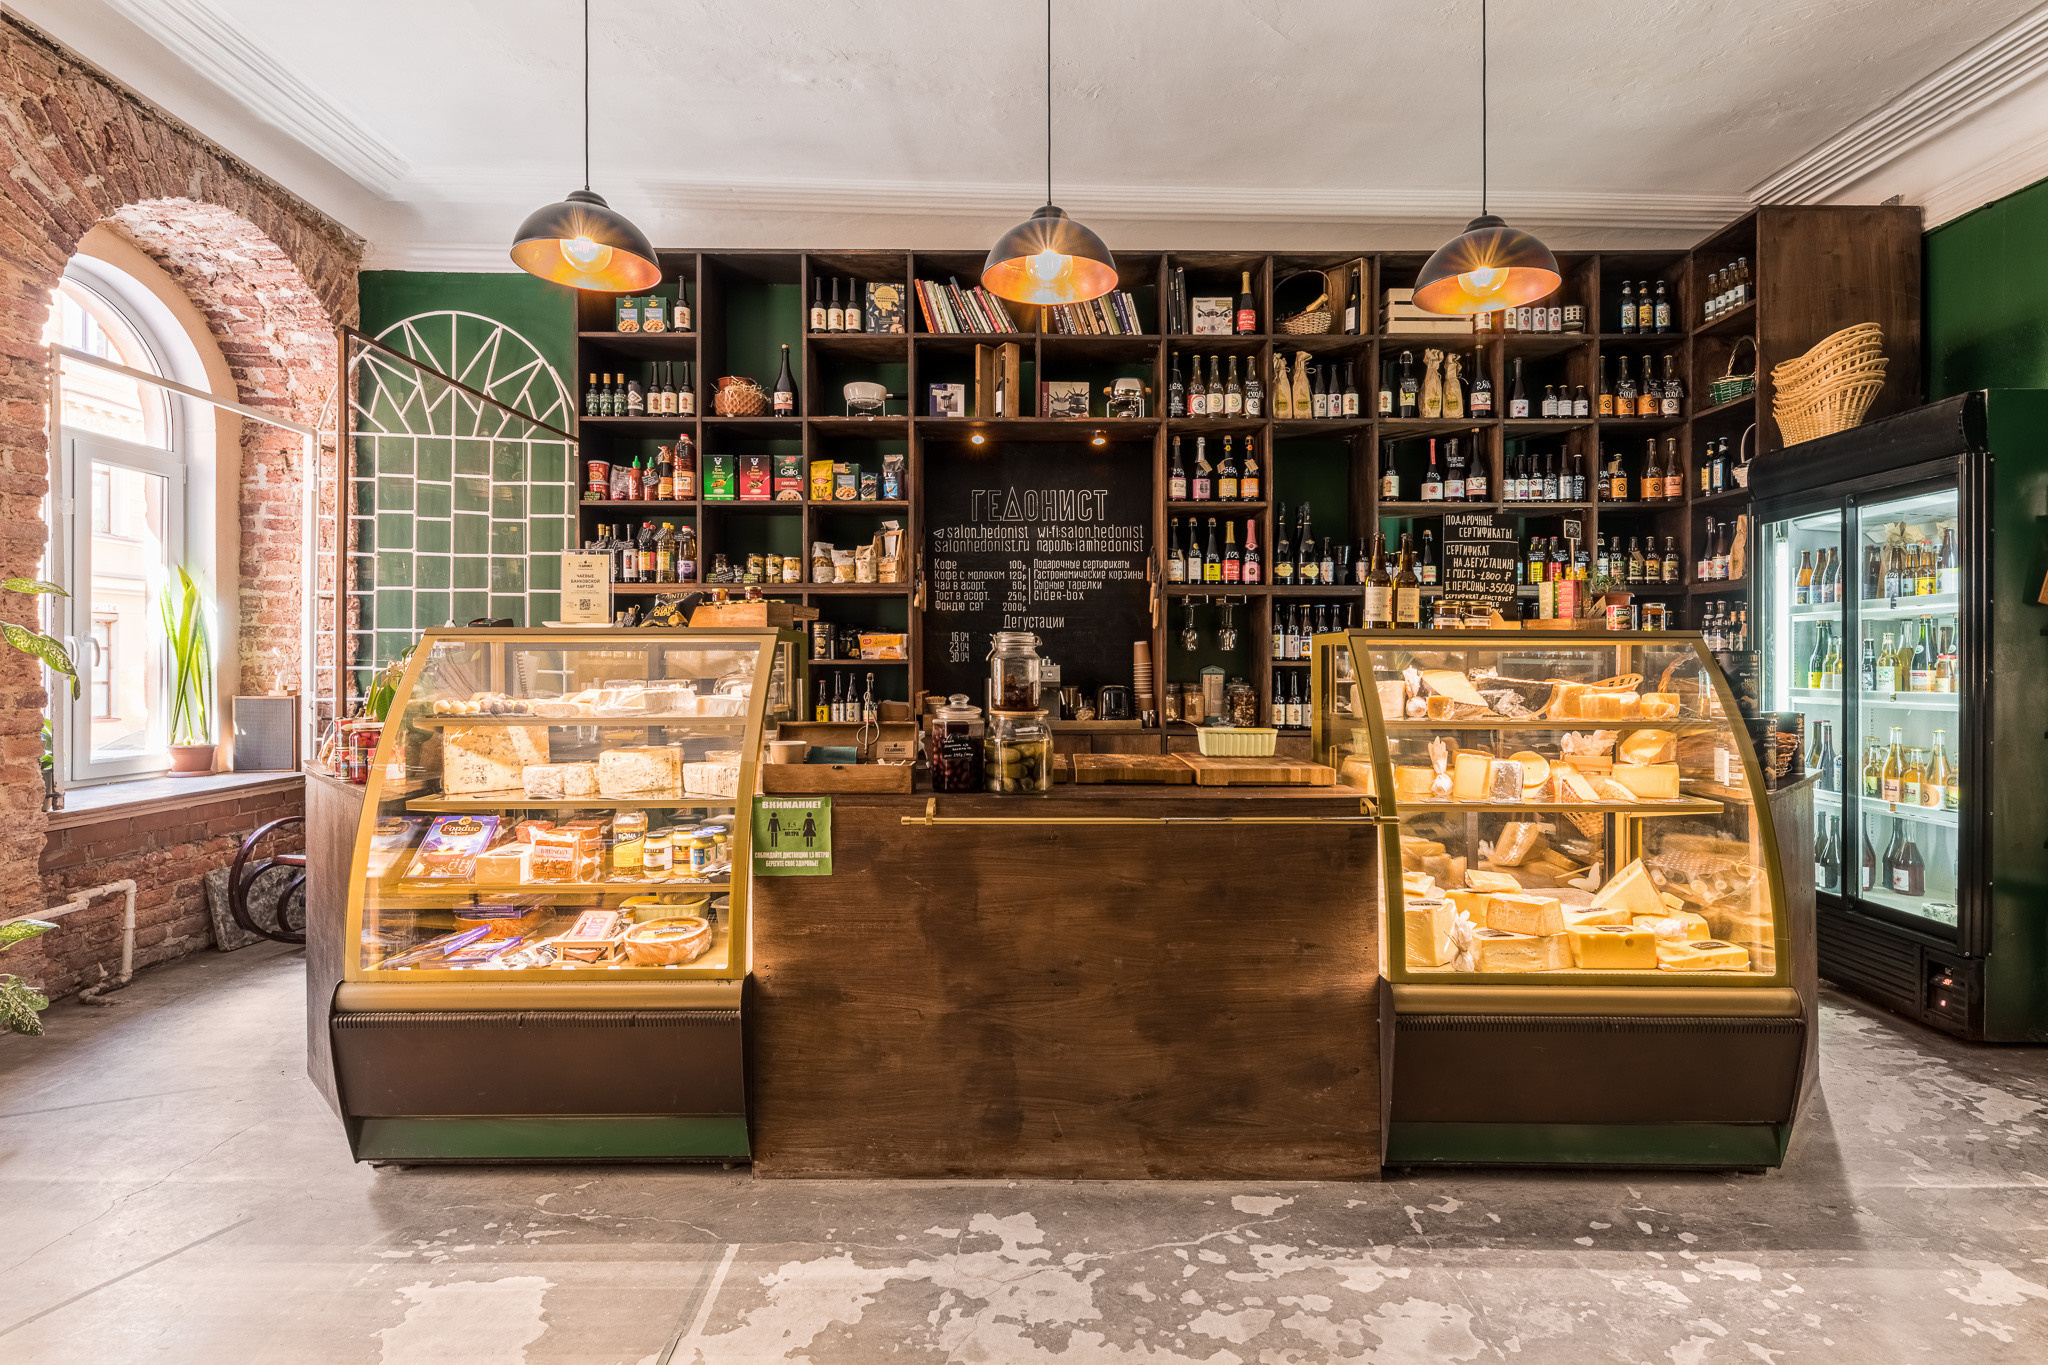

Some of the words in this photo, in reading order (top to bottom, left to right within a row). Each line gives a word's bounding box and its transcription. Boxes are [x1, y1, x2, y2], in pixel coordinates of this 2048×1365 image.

[781, 468, 803, 476] Gallo
[972, 486, 1108, 522] ГЕДОНИСТ
[1445, 515, 1493, 526] ПОДАРОЧНЫЕ
[947, 523, 1029, 539] salon_hedonist
[1459, 527, 1512, 539] СЕРТИФИКАТЫ
[934, 539, 1030, 552] salonhedonist.ru
[1446, 545, 1490, 556] СЕРТИФИКАТ
[934, 558, 957, 570] Кофе
[1033, 559, 1080, 570] Подарочные
[1082, 560, 1130, 571] сертификаты
[1453, 558, 1462, 568] НА
[1463, 557, 1514, 570] ДЕГУСТАЦИЮ
[934, 570, 957, 581] Кофе
[968, 571, 1005, 580] молоком
[1033, 569, 1106, 581] Гастрономические
[1109, 570, 1144, 581] корзины
[934, 581, 951, 591] Чай
[1033, 580, 1065, 591] Сырные
[1068, 581, 1103, 591] тарелки
[935, 591, 954, 600] Тост
[935, 600, 965, 612] Фондю
[969, 602, 984, 611] сет
[1002, 614, 1065, 631] Дегустации
[761, 800, 822, 809] ВНИМАНИЕ!
